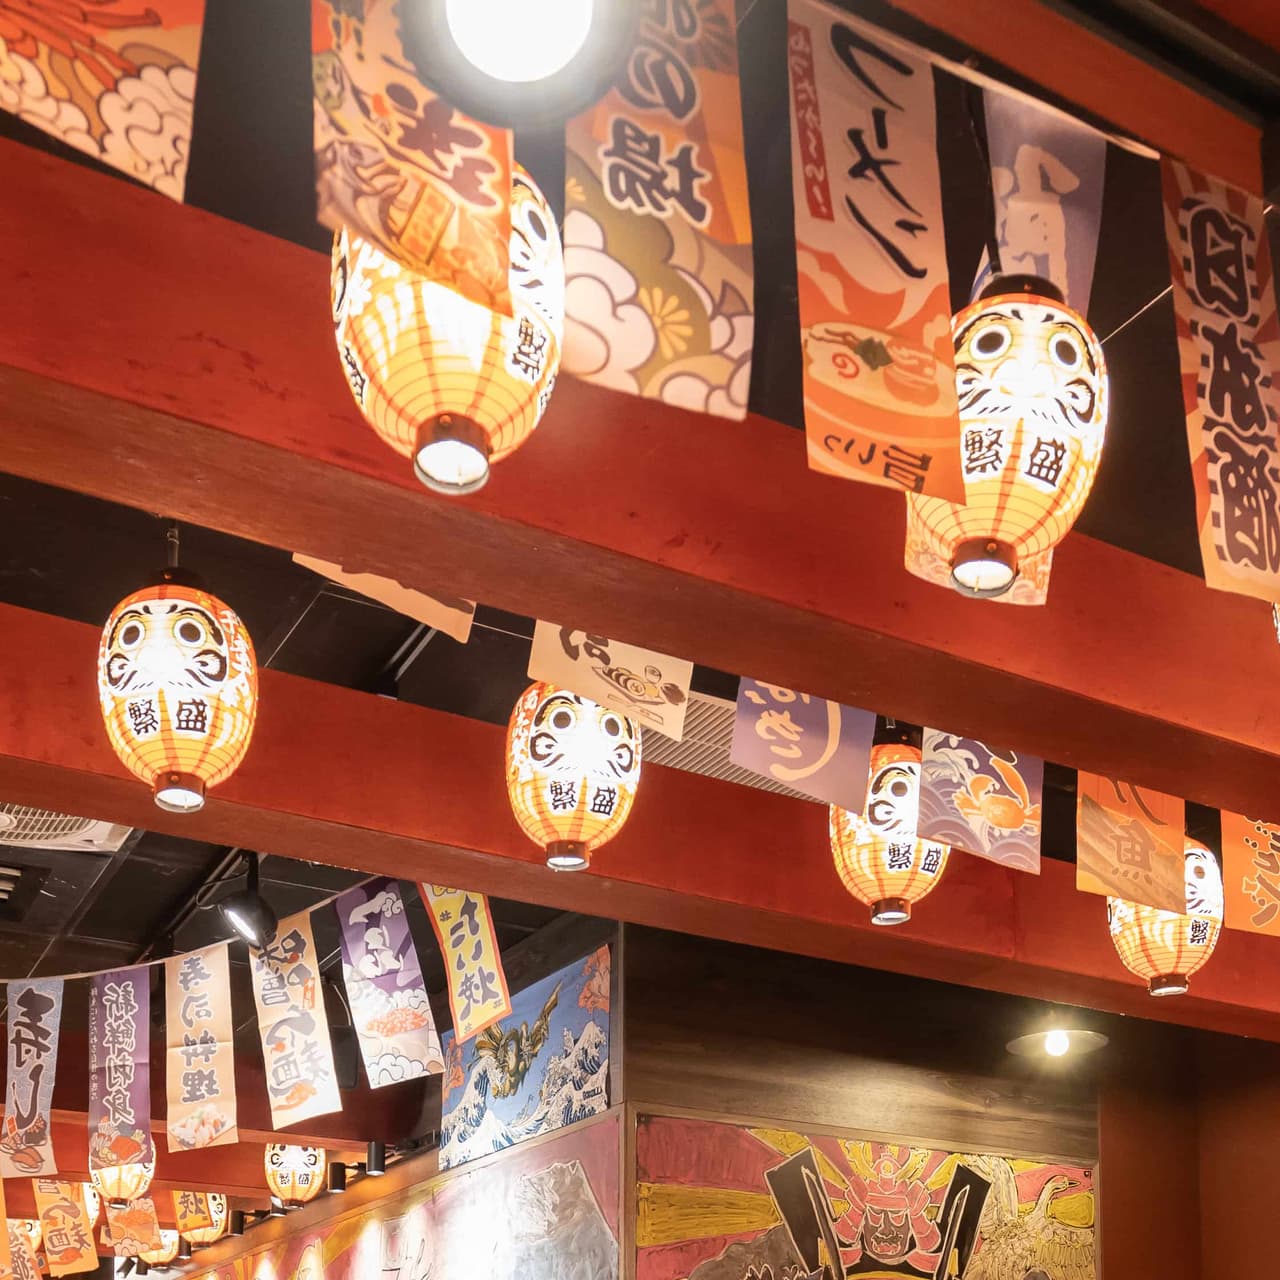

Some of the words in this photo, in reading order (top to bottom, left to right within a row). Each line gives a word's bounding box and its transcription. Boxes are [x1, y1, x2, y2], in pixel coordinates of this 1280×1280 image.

[964, 428, 1067, 488] 繁盛
[128, 699, 208, 735] 繁盛
[549, 781, 616, 816] 繁盛
[888, 843, 941, 874] 繁盛
